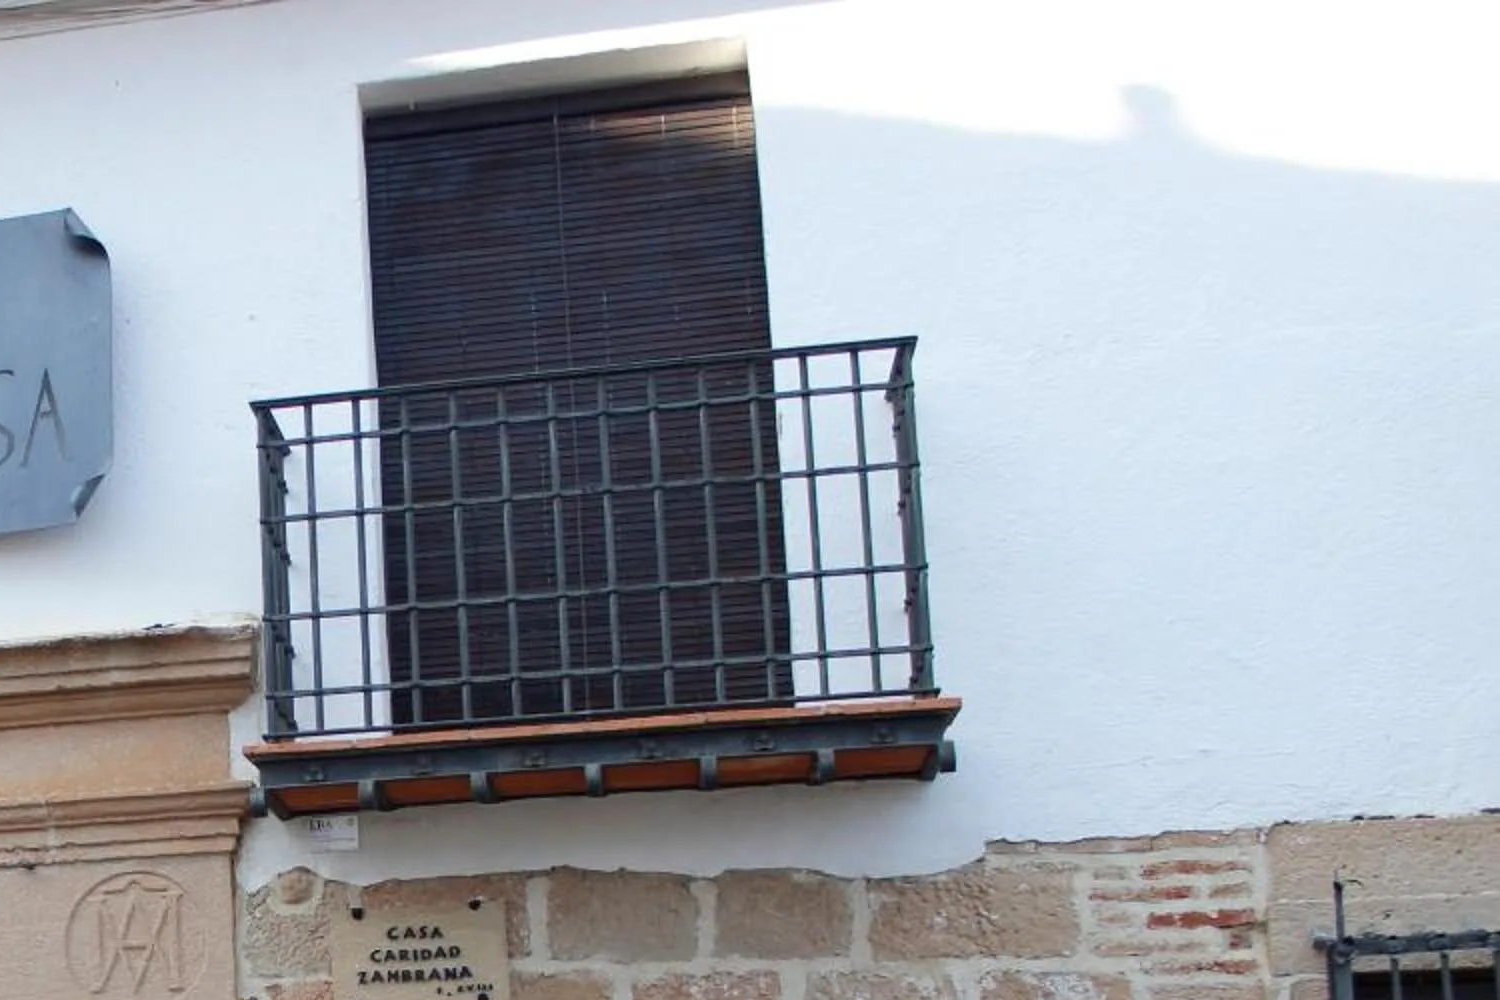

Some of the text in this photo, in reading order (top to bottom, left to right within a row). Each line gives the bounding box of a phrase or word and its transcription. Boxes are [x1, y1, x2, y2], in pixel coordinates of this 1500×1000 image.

[387, 925, 444, 940] CASA
[370, 945, 461, 963] CARIDAD
[357, 965, 474, 985] ZAMBRANA
